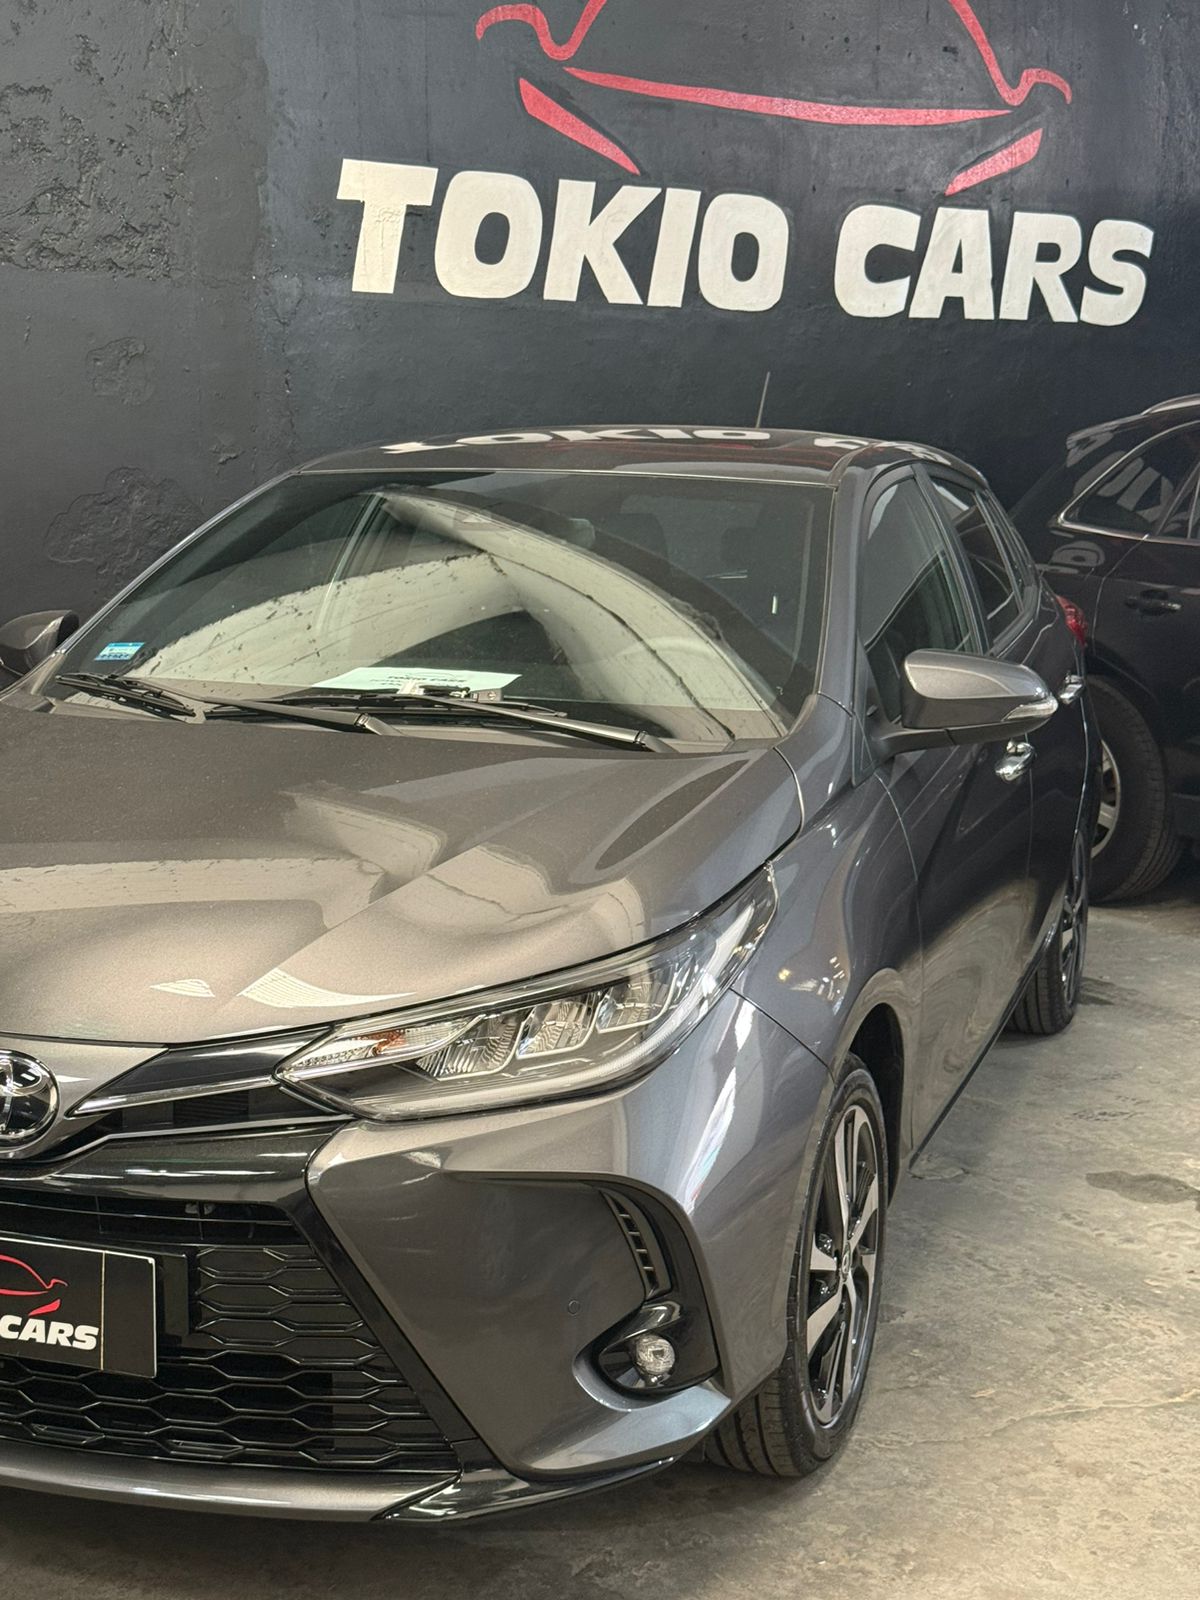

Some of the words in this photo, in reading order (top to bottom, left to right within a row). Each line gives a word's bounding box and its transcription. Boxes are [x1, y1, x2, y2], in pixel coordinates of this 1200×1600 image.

[337, 158, 789, 311] TOKIO
[834, 204, 1154, 326] CARS
[0, 1315, 99, 1350] CARS
